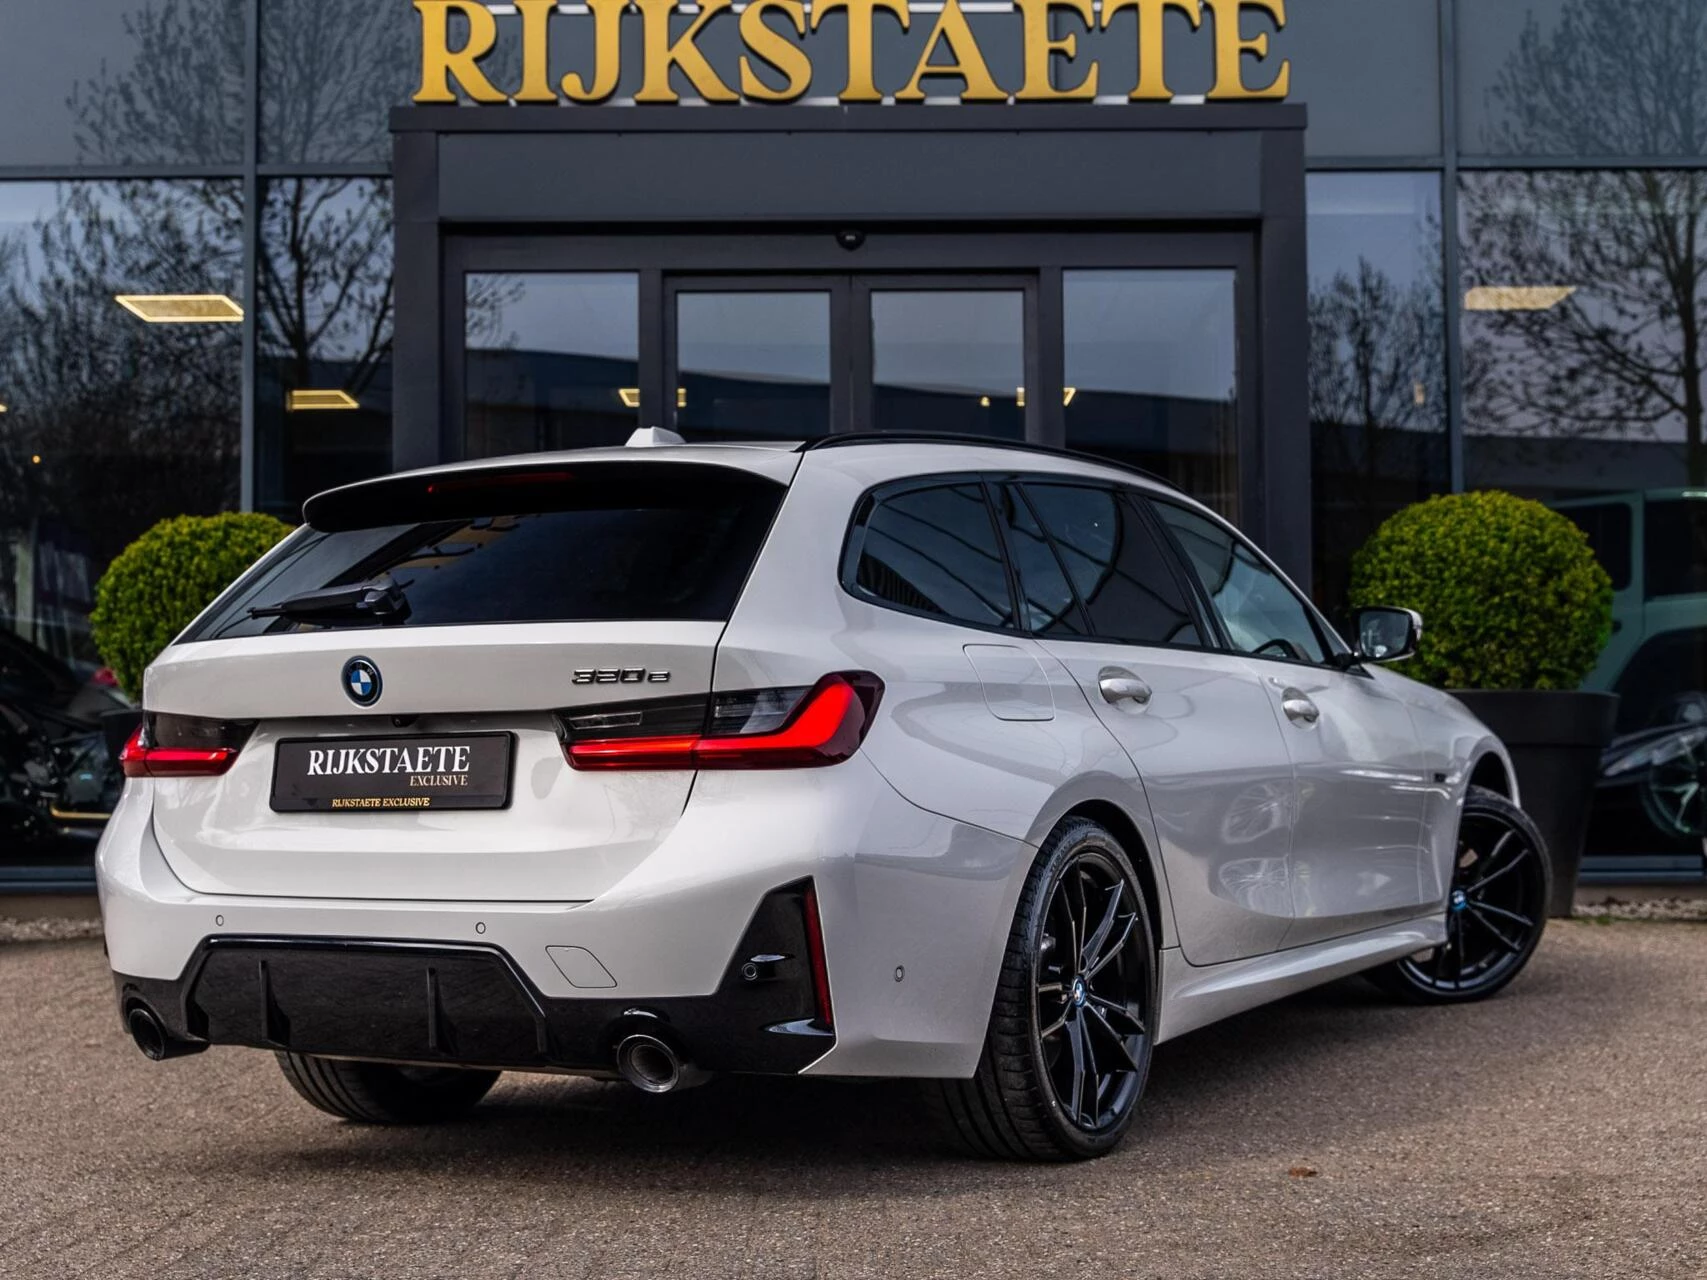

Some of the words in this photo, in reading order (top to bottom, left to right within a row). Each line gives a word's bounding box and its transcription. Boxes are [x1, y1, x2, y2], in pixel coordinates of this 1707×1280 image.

[412, 0, 1291, 104] RIJKSTAETE
[307, 745, 470, 776] RIJKSTAETE
[409, 774, 468, 787] EXCLUSIVE
[332, 798, 381, 808] RIJKSTAETE
[382, 797, 430, 807] EXCLUSIVE
